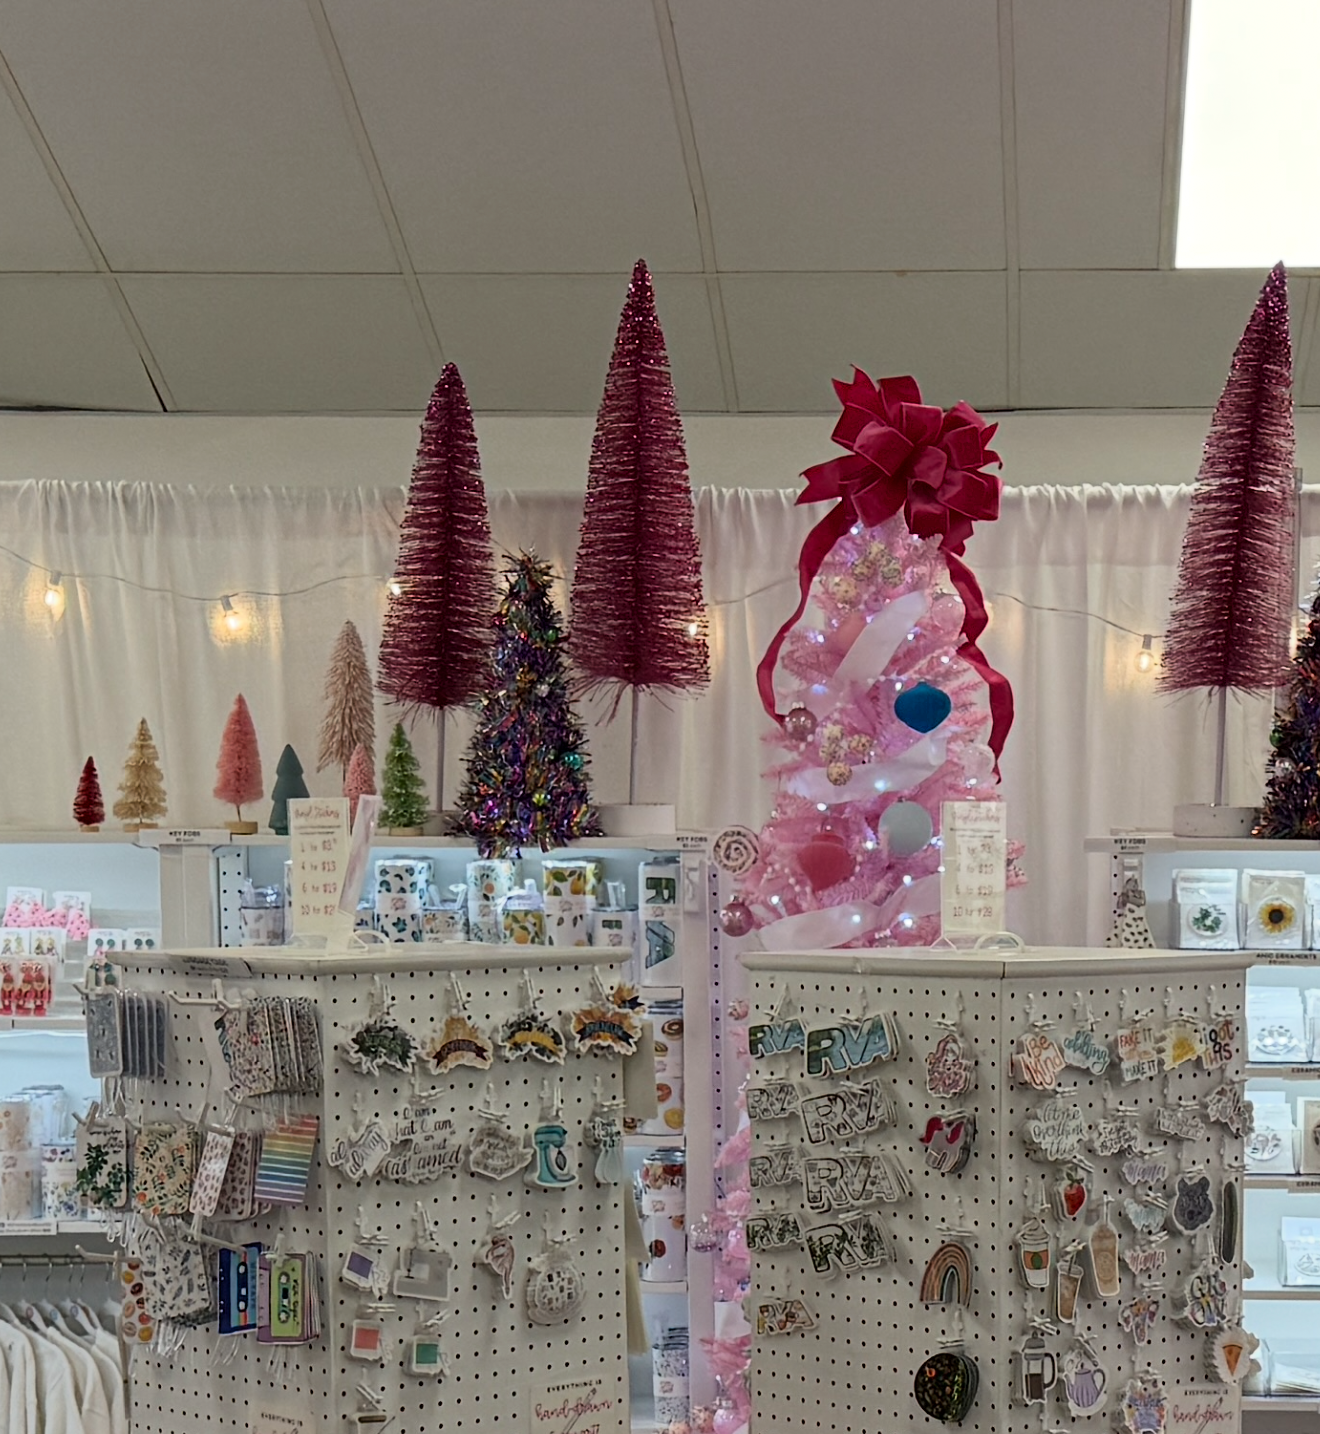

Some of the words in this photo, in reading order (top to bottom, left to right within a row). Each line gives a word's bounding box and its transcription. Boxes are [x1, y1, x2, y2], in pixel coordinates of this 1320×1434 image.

[324, 904, 335, 915] $2
[748, 1019, 805, 1056] RVA
[807, 1014, 890, 1075] RVA
[802, 1080, 886, 1144] RVA
[804, 1156, 896, 1204] RVA
[806, 1213, 888, 1273] RVA
[547, 1381, 593, 1393] EVERYTHING
